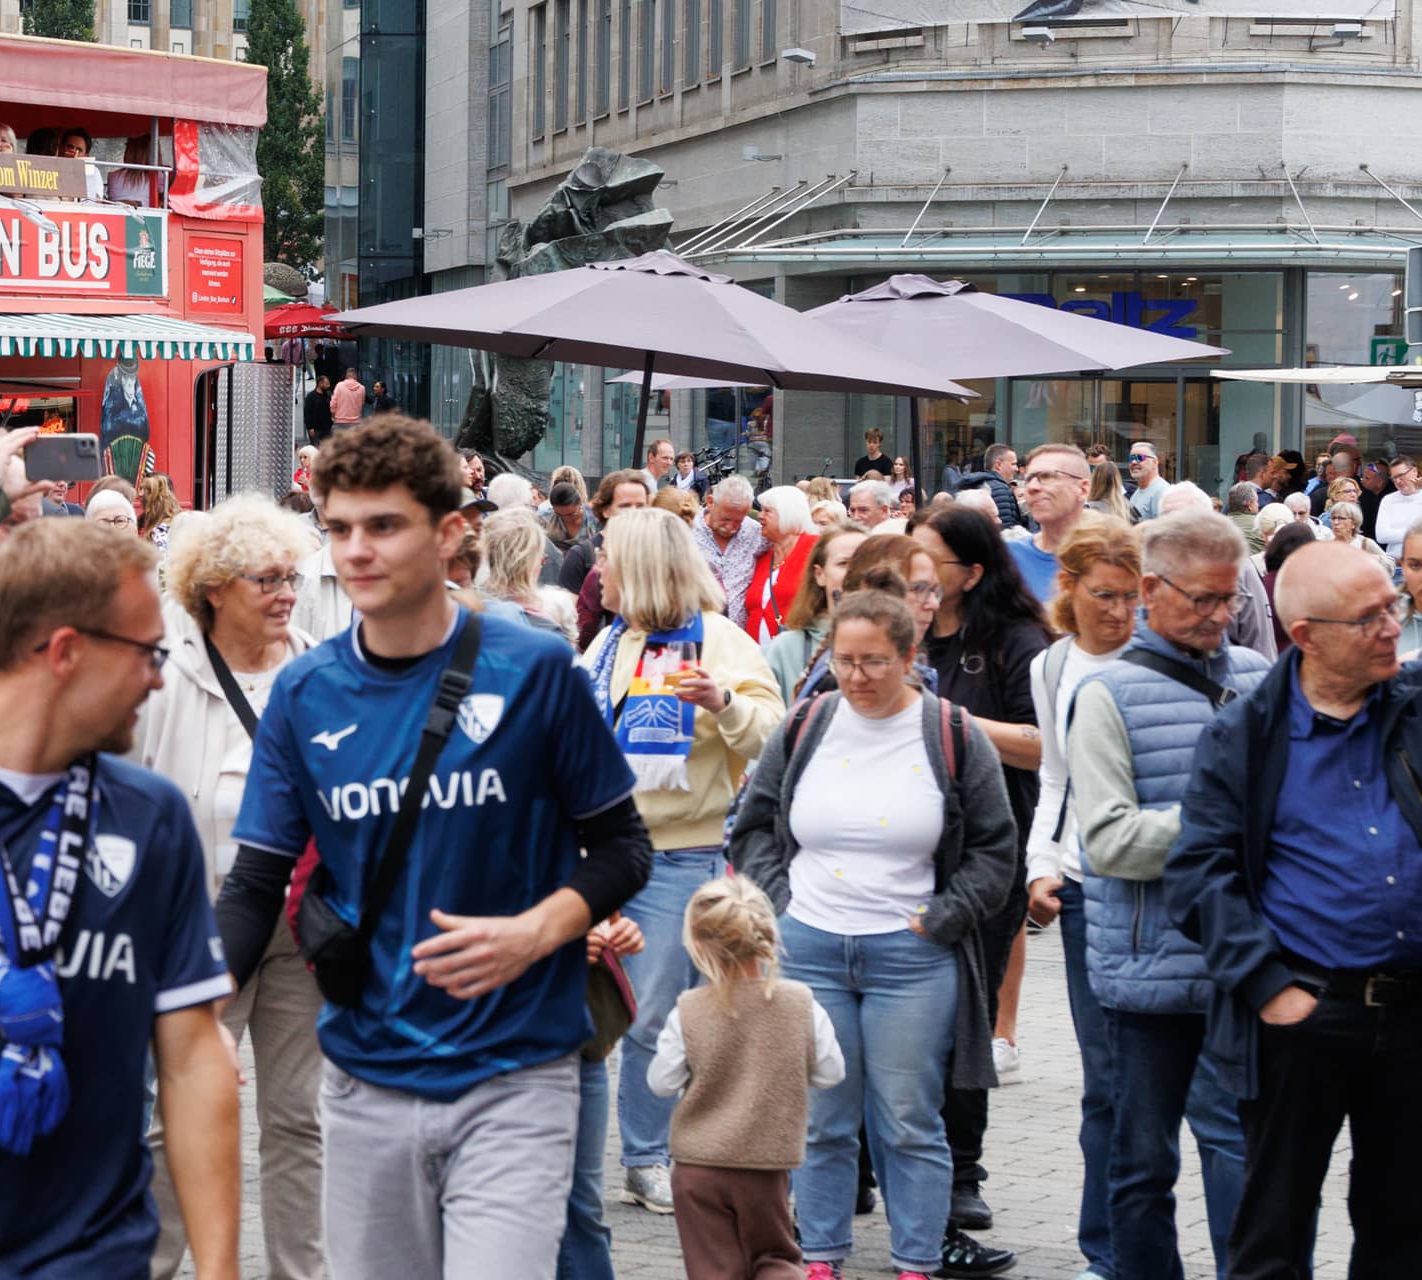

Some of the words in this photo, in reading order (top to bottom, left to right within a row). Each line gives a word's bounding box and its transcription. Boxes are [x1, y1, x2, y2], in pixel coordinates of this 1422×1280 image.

[16, 160, 59, 190] Winzer
[38, 221, 109, 279] BUS
[996, 292, 1198, 338] altz
[43, 830, 83, 945] LIEBE
